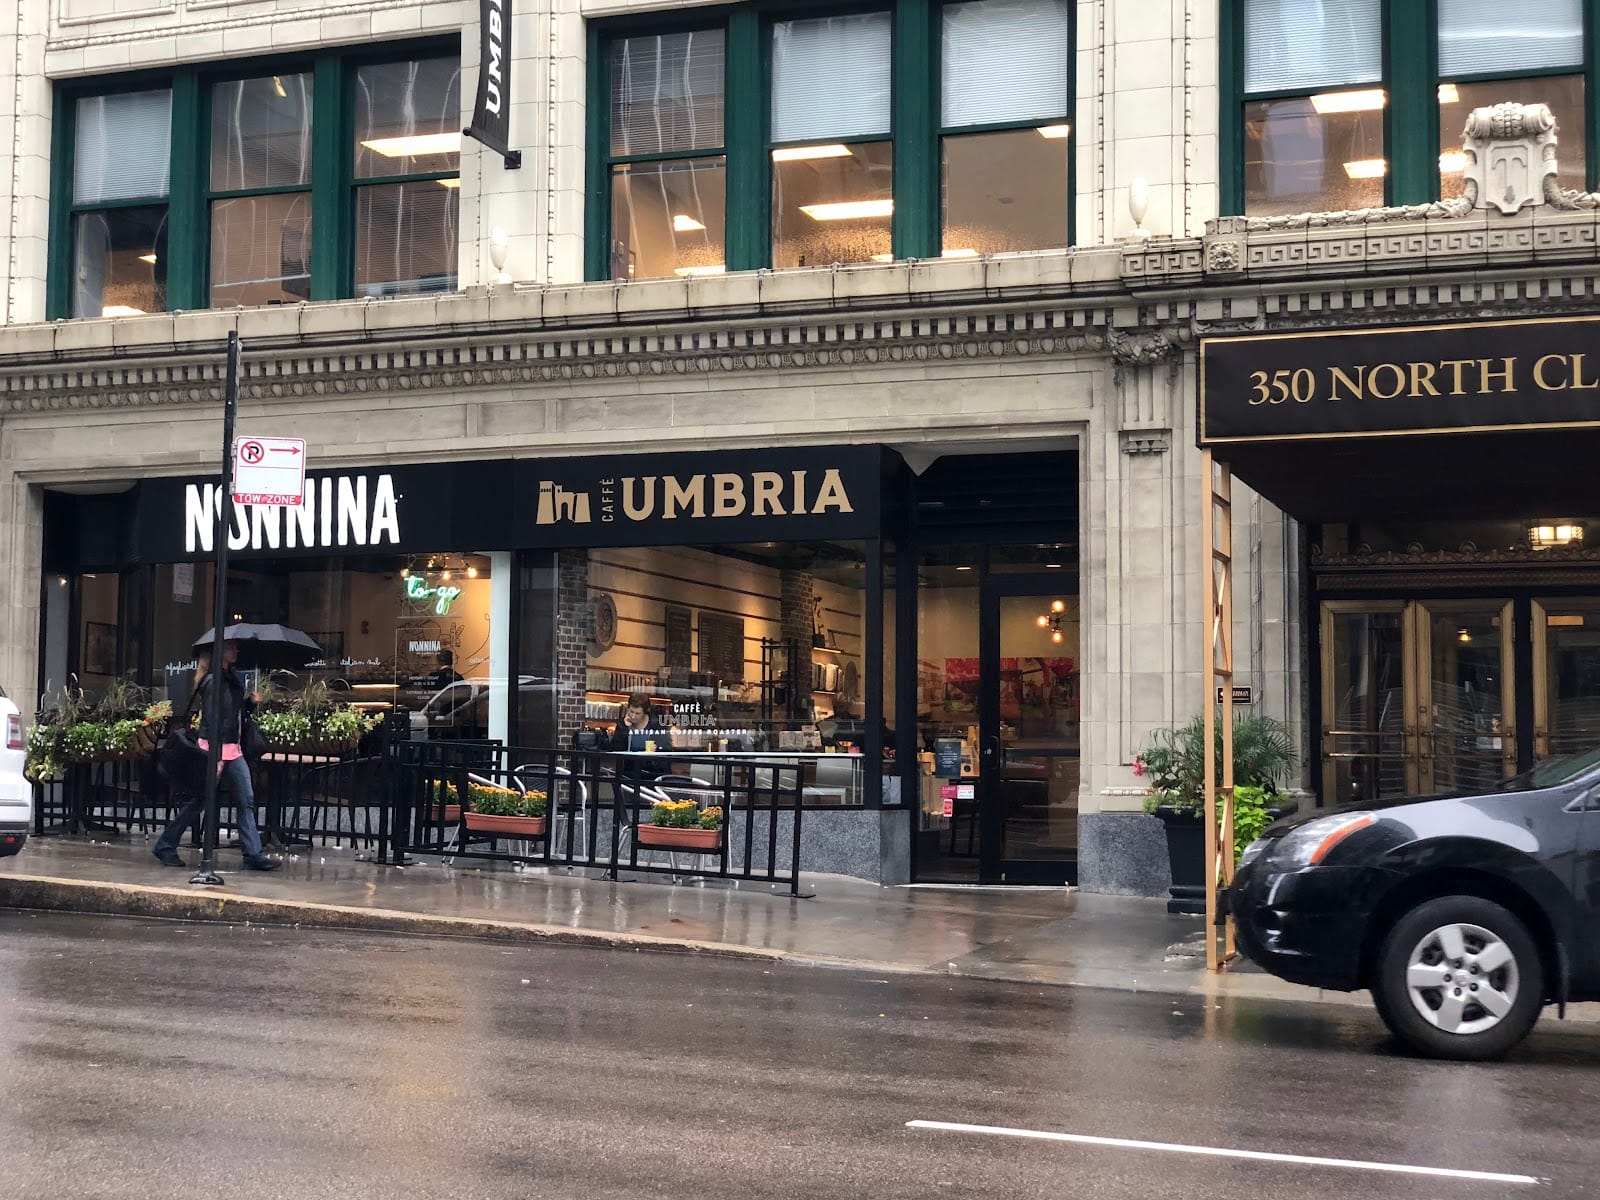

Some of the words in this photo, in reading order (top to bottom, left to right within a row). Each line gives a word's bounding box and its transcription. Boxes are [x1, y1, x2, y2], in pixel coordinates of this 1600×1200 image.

[1248, 368, 1315, 405] 350
[1327, 357, 1517, 401] NORTH
[238, 494, 260, 503] TOW
[267, 495, 296, 504] ZONE
[600, 478, 614, 523] CAFFÈ
[621, 469, 854, 521] UMBRIA
[658, 714, 716, 726] UMBRIA
[673, 701, 701, 713] CAFFÈ
